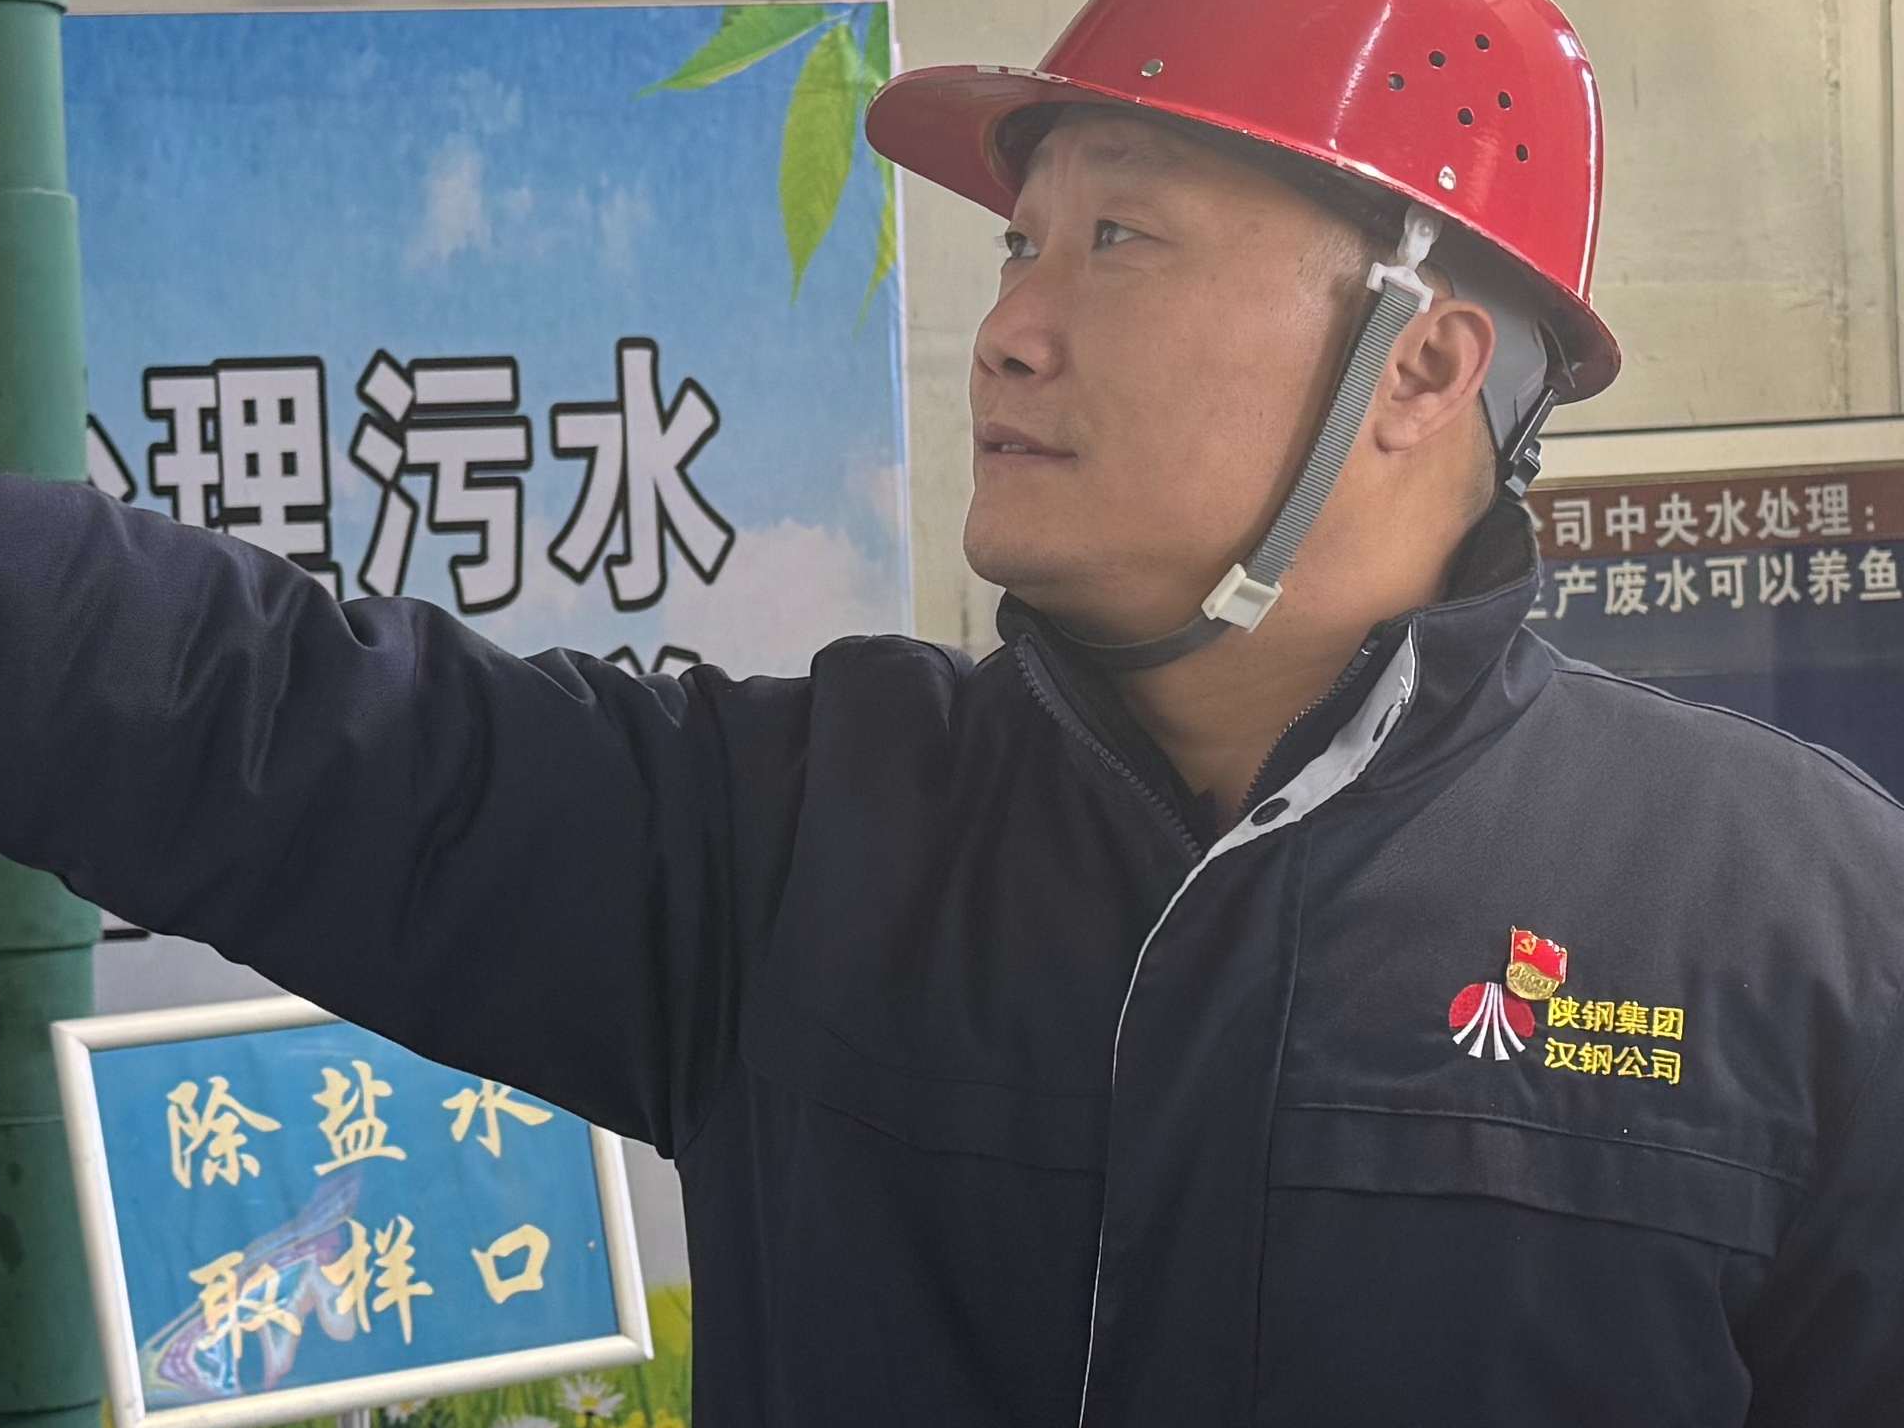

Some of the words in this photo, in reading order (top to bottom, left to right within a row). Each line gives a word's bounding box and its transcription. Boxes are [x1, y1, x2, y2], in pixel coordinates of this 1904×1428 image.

[86, 336, 736, 616] 理污水
[1526, 483, 1879, 553] 司中央水处理：
[1524, 546, 1904, 620] 产废水可以养鱼
[1547, 995, 1684, 1041] 陕钢集团
[1544, 1036, 1681, 1085] 汉钢公司
[166, 1060, 554, 1190] 除盐水
[190, 1214, 552, 1360] 取样口
